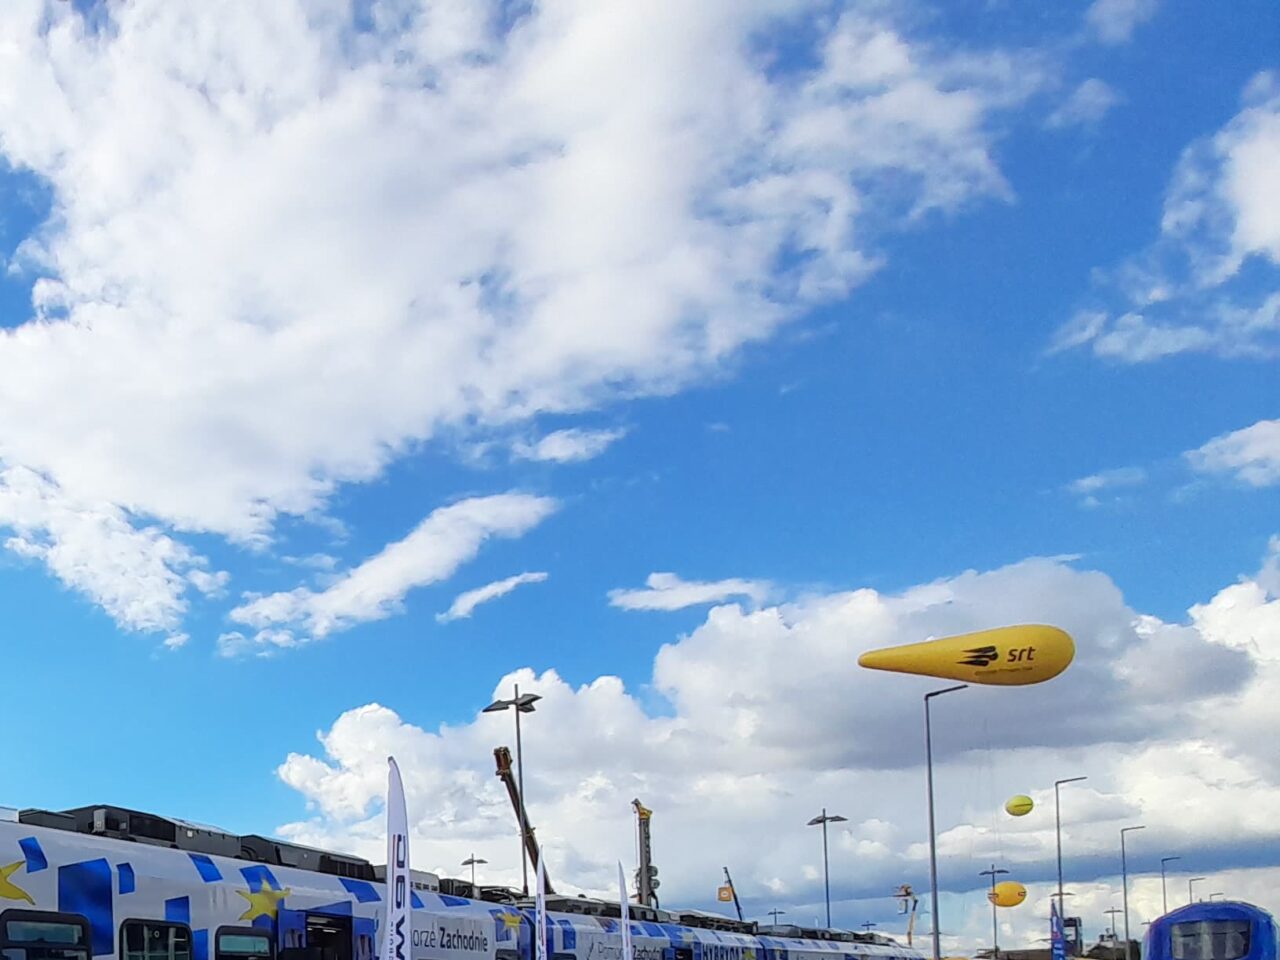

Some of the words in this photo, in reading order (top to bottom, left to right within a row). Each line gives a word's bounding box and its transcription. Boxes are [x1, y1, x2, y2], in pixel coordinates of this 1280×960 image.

[1007, 646, 1037, 663] srt
[412, 929, 437, 949] orze
[439, 926, 488, 953] Zachodnie
